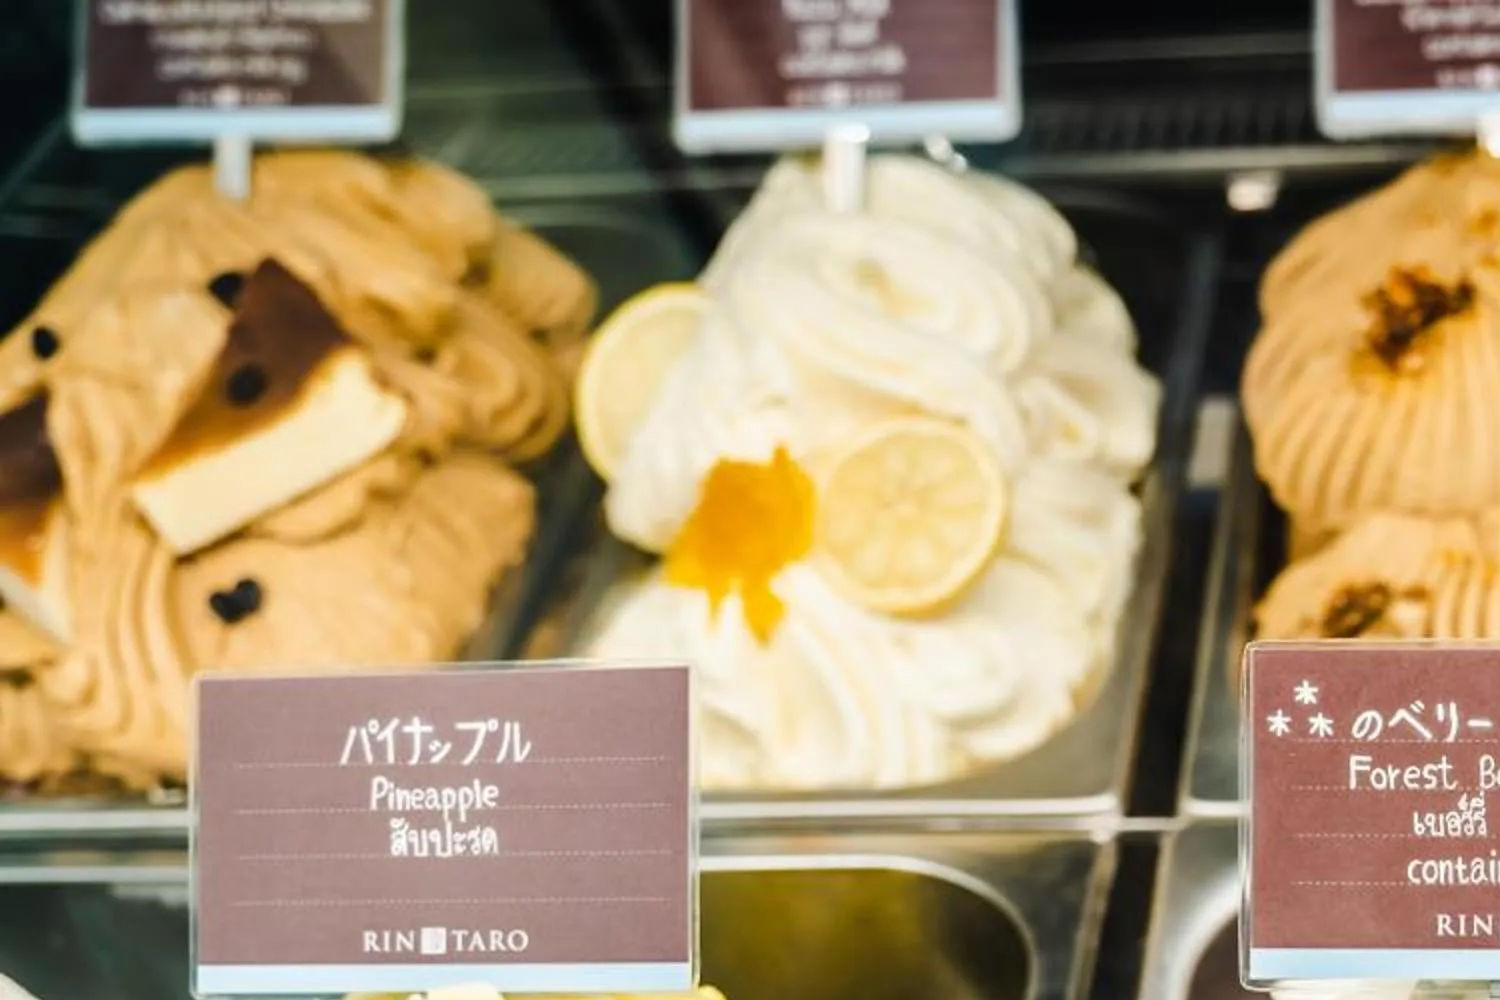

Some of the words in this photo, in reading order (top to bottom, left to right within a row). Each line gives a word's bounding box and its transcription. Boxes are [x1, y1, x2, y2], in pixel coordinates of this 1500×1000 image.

[341, 717, 530, 765] パイナップル
[1349, 756, 1458, 790] Forest
[371, 776, 499, 822] Pineapple
[390, 817, 498, 858] สับปะรด
[363, 930, 415, 952] RIN
[451, 930, 529, 952] TARO
[1437, 914, 1493, 937] RIN
